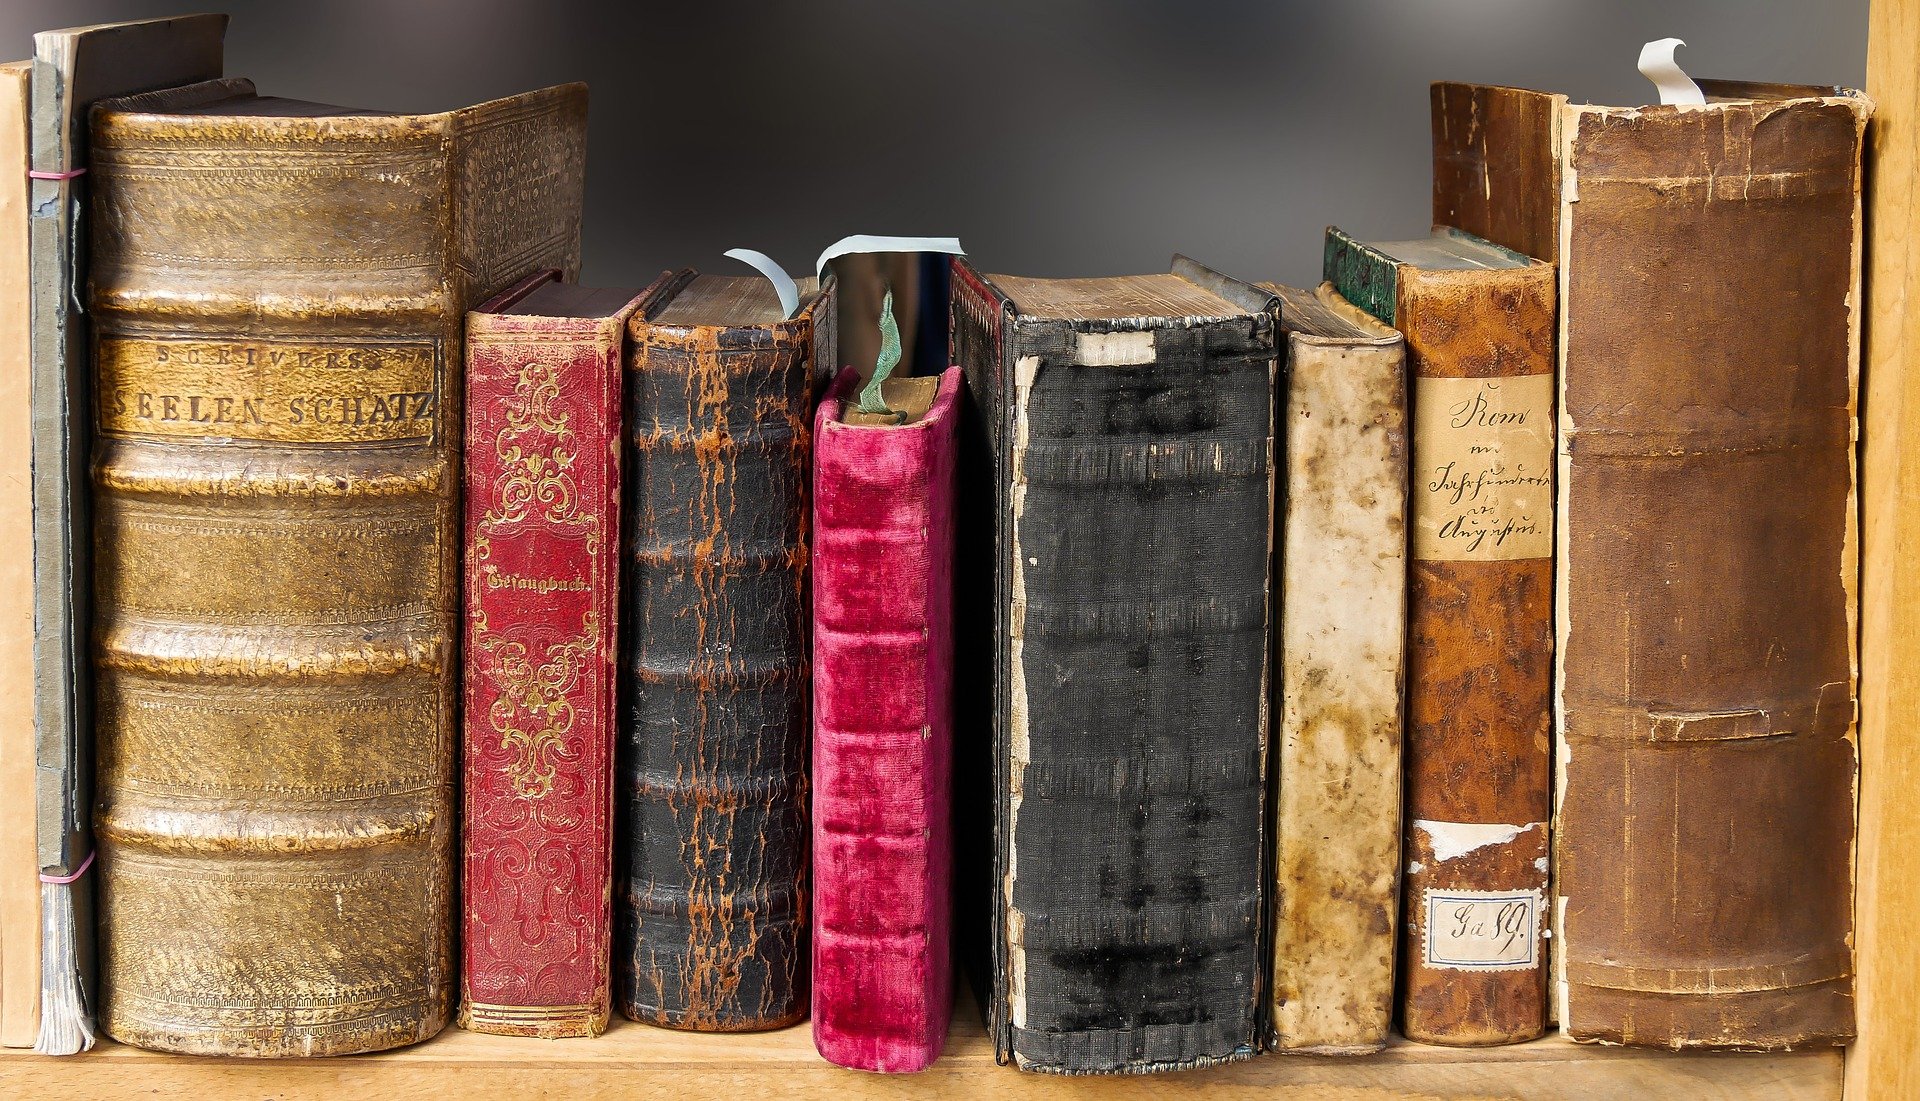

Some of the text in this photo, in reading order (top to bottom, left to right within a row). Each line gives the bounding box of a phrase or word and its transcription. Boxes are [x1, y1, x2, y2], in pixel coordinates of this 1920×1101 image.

[113, 391, 434, 426] SEELEN SCHATZ
[1449, 382, 1531, 429] Rom
